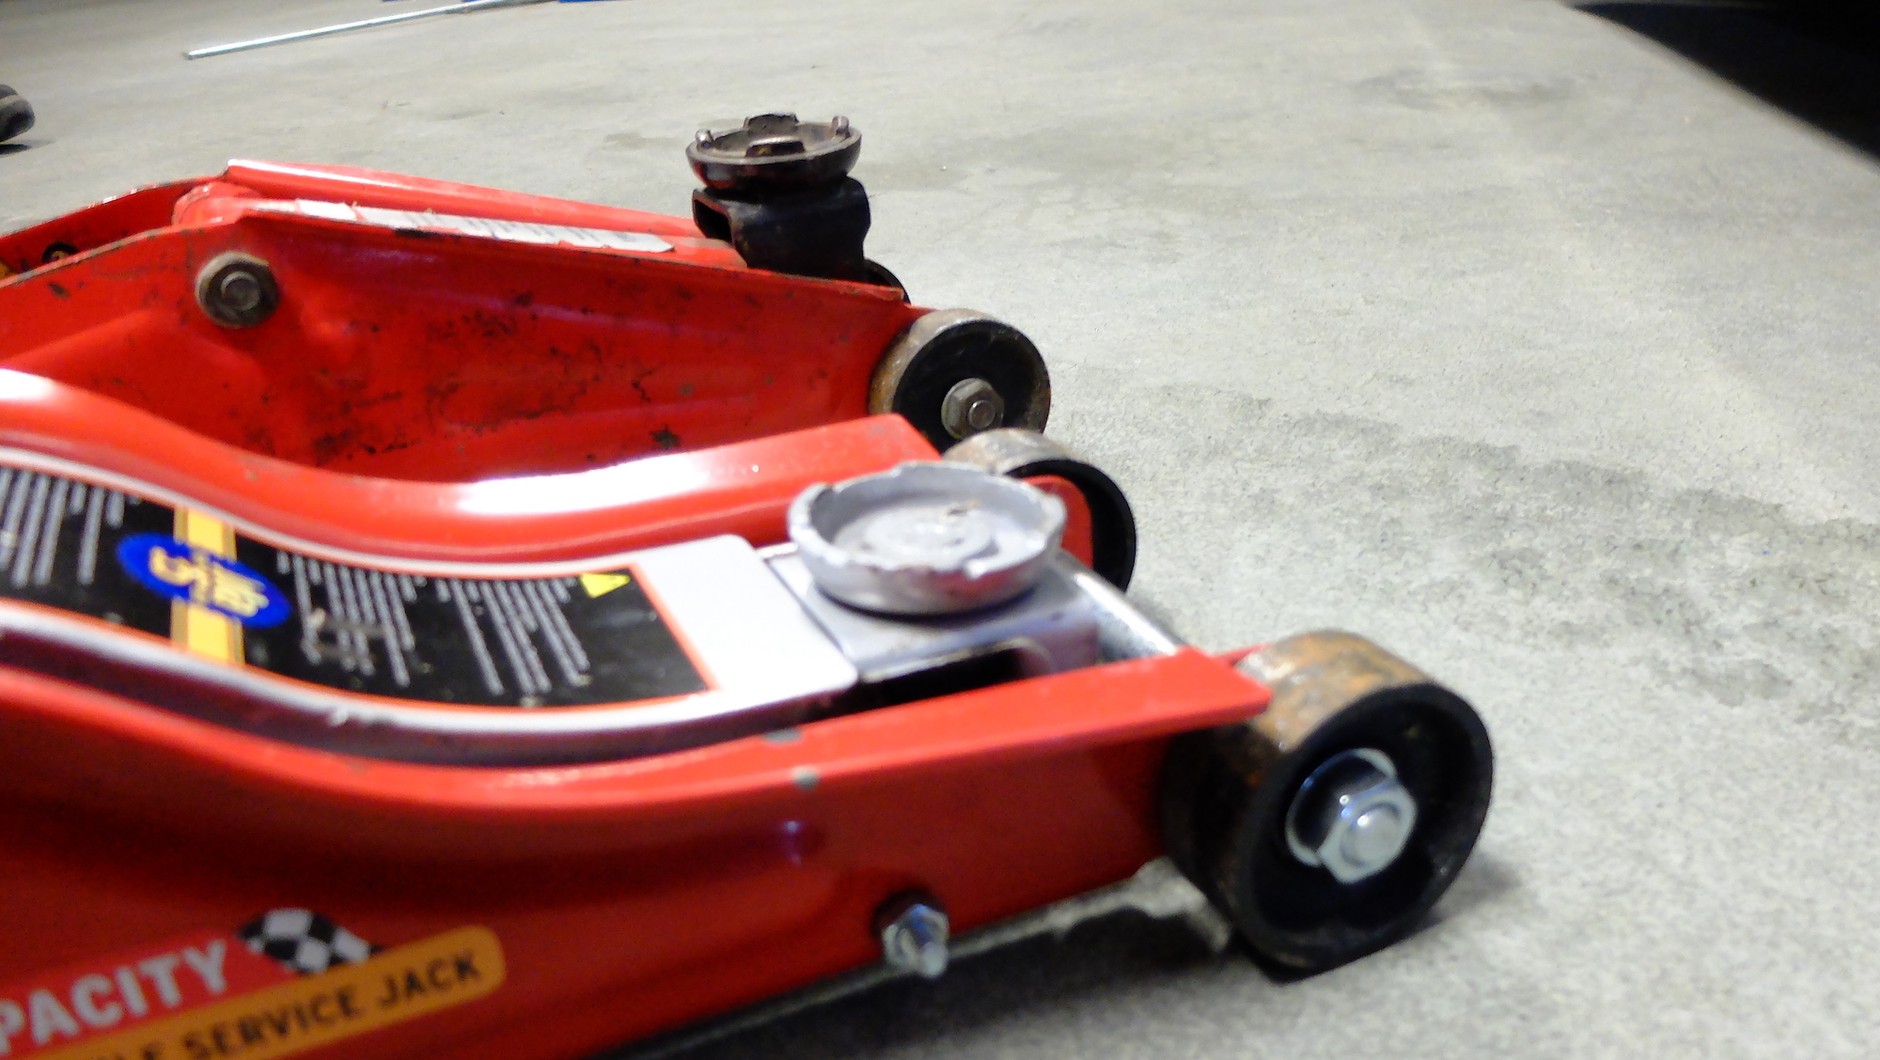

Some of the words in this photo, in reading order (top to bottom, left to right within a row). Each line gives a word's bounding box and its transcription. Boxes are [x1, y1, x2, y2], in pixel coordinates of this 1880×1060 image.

[0, 940, 227, 1057] PACITY
[183, 984, 361, 1060] SERVICE
[377, 951, 480, 1007] JACK
